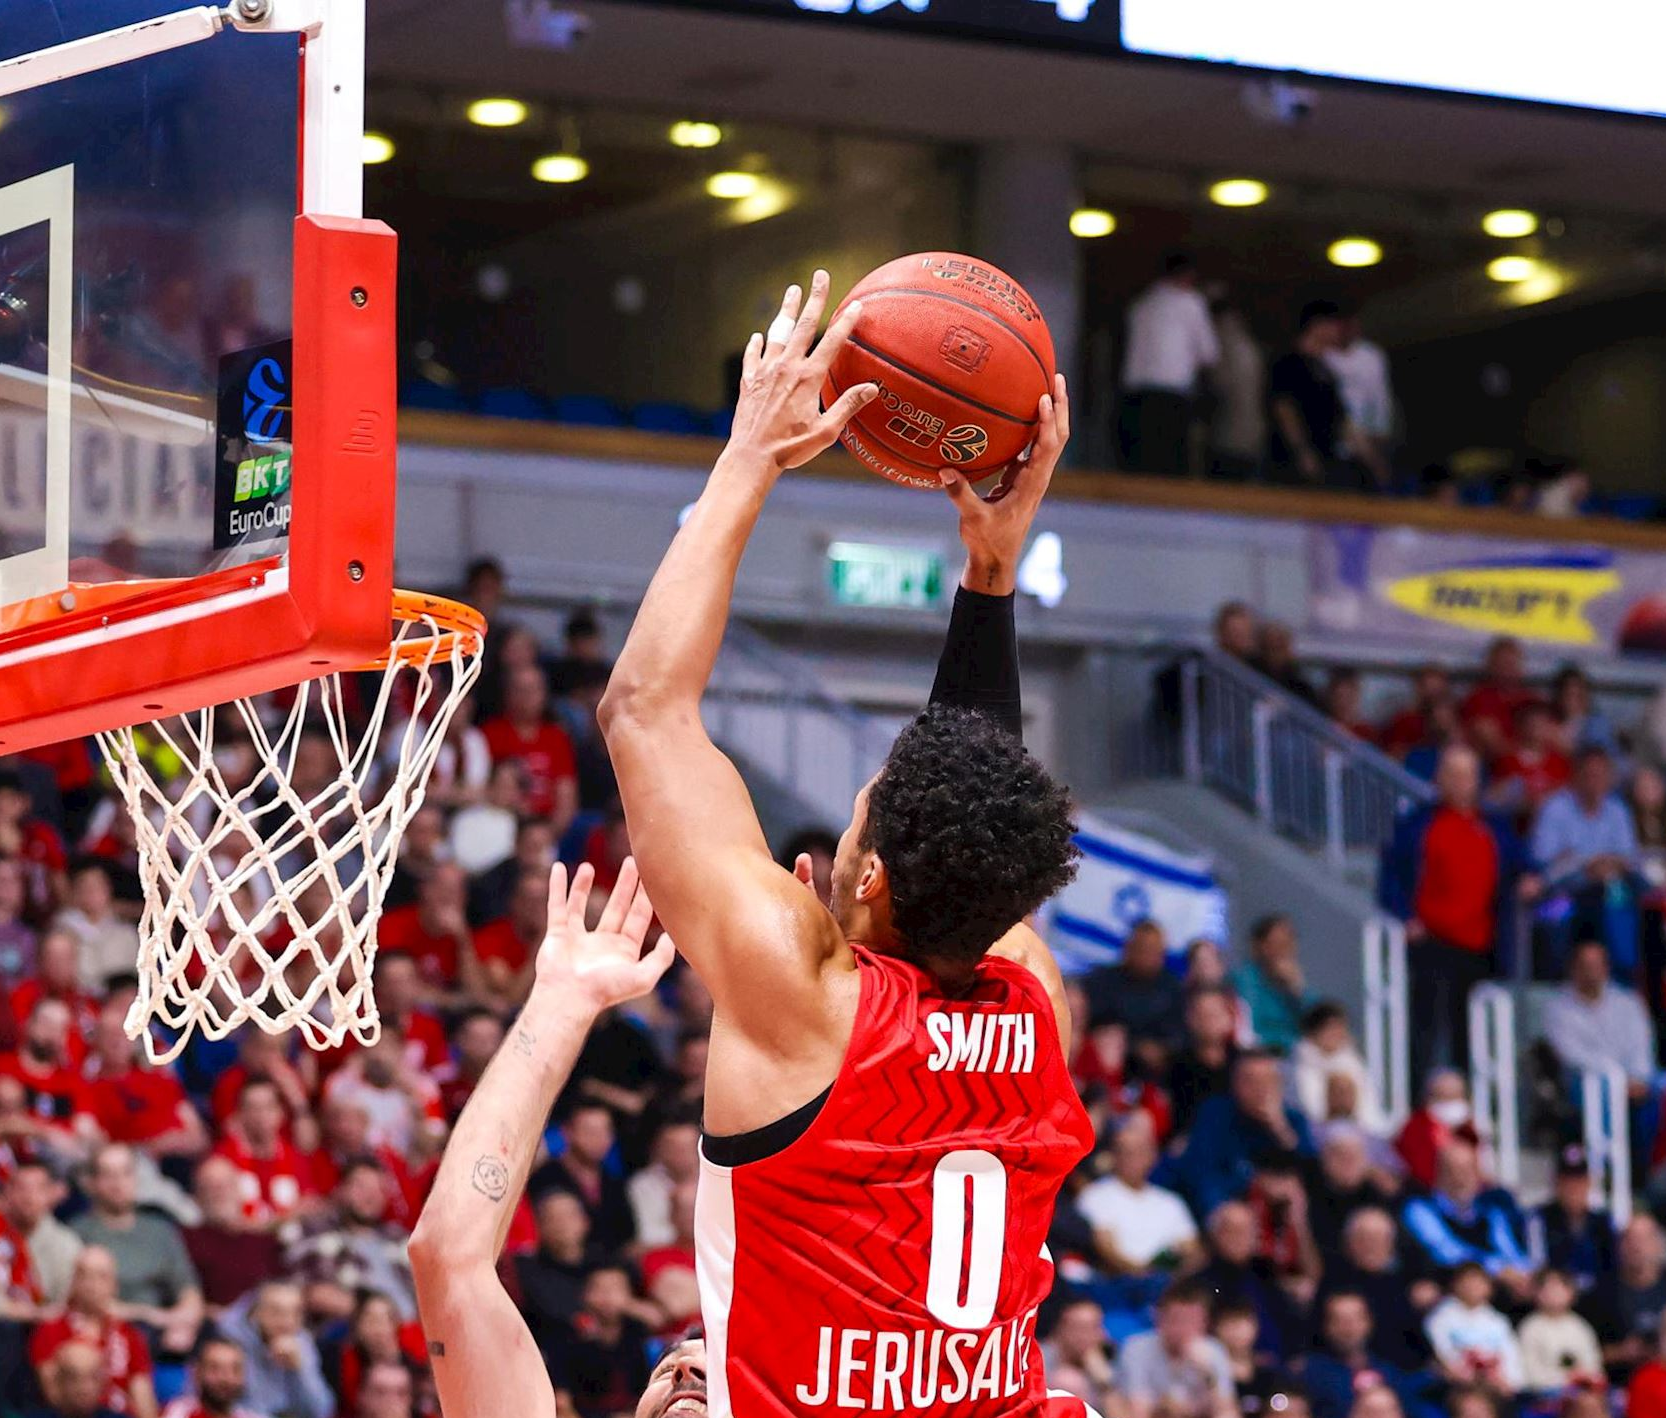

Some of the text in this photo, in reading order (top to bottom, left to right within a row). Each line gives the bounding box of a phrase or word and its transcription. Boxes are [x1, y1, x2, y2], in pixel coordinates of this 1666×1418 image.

[237, 455, 291, 496] BKT
[229, 502, 292, 535] EuroCup
[1017, 531, 1068, 608] 4
[926, 1012, 1036, 1074] SMITH
[926, 1149, 1007, 1330] 0
[795, 1306, 1039, 1411] JERUSALE
